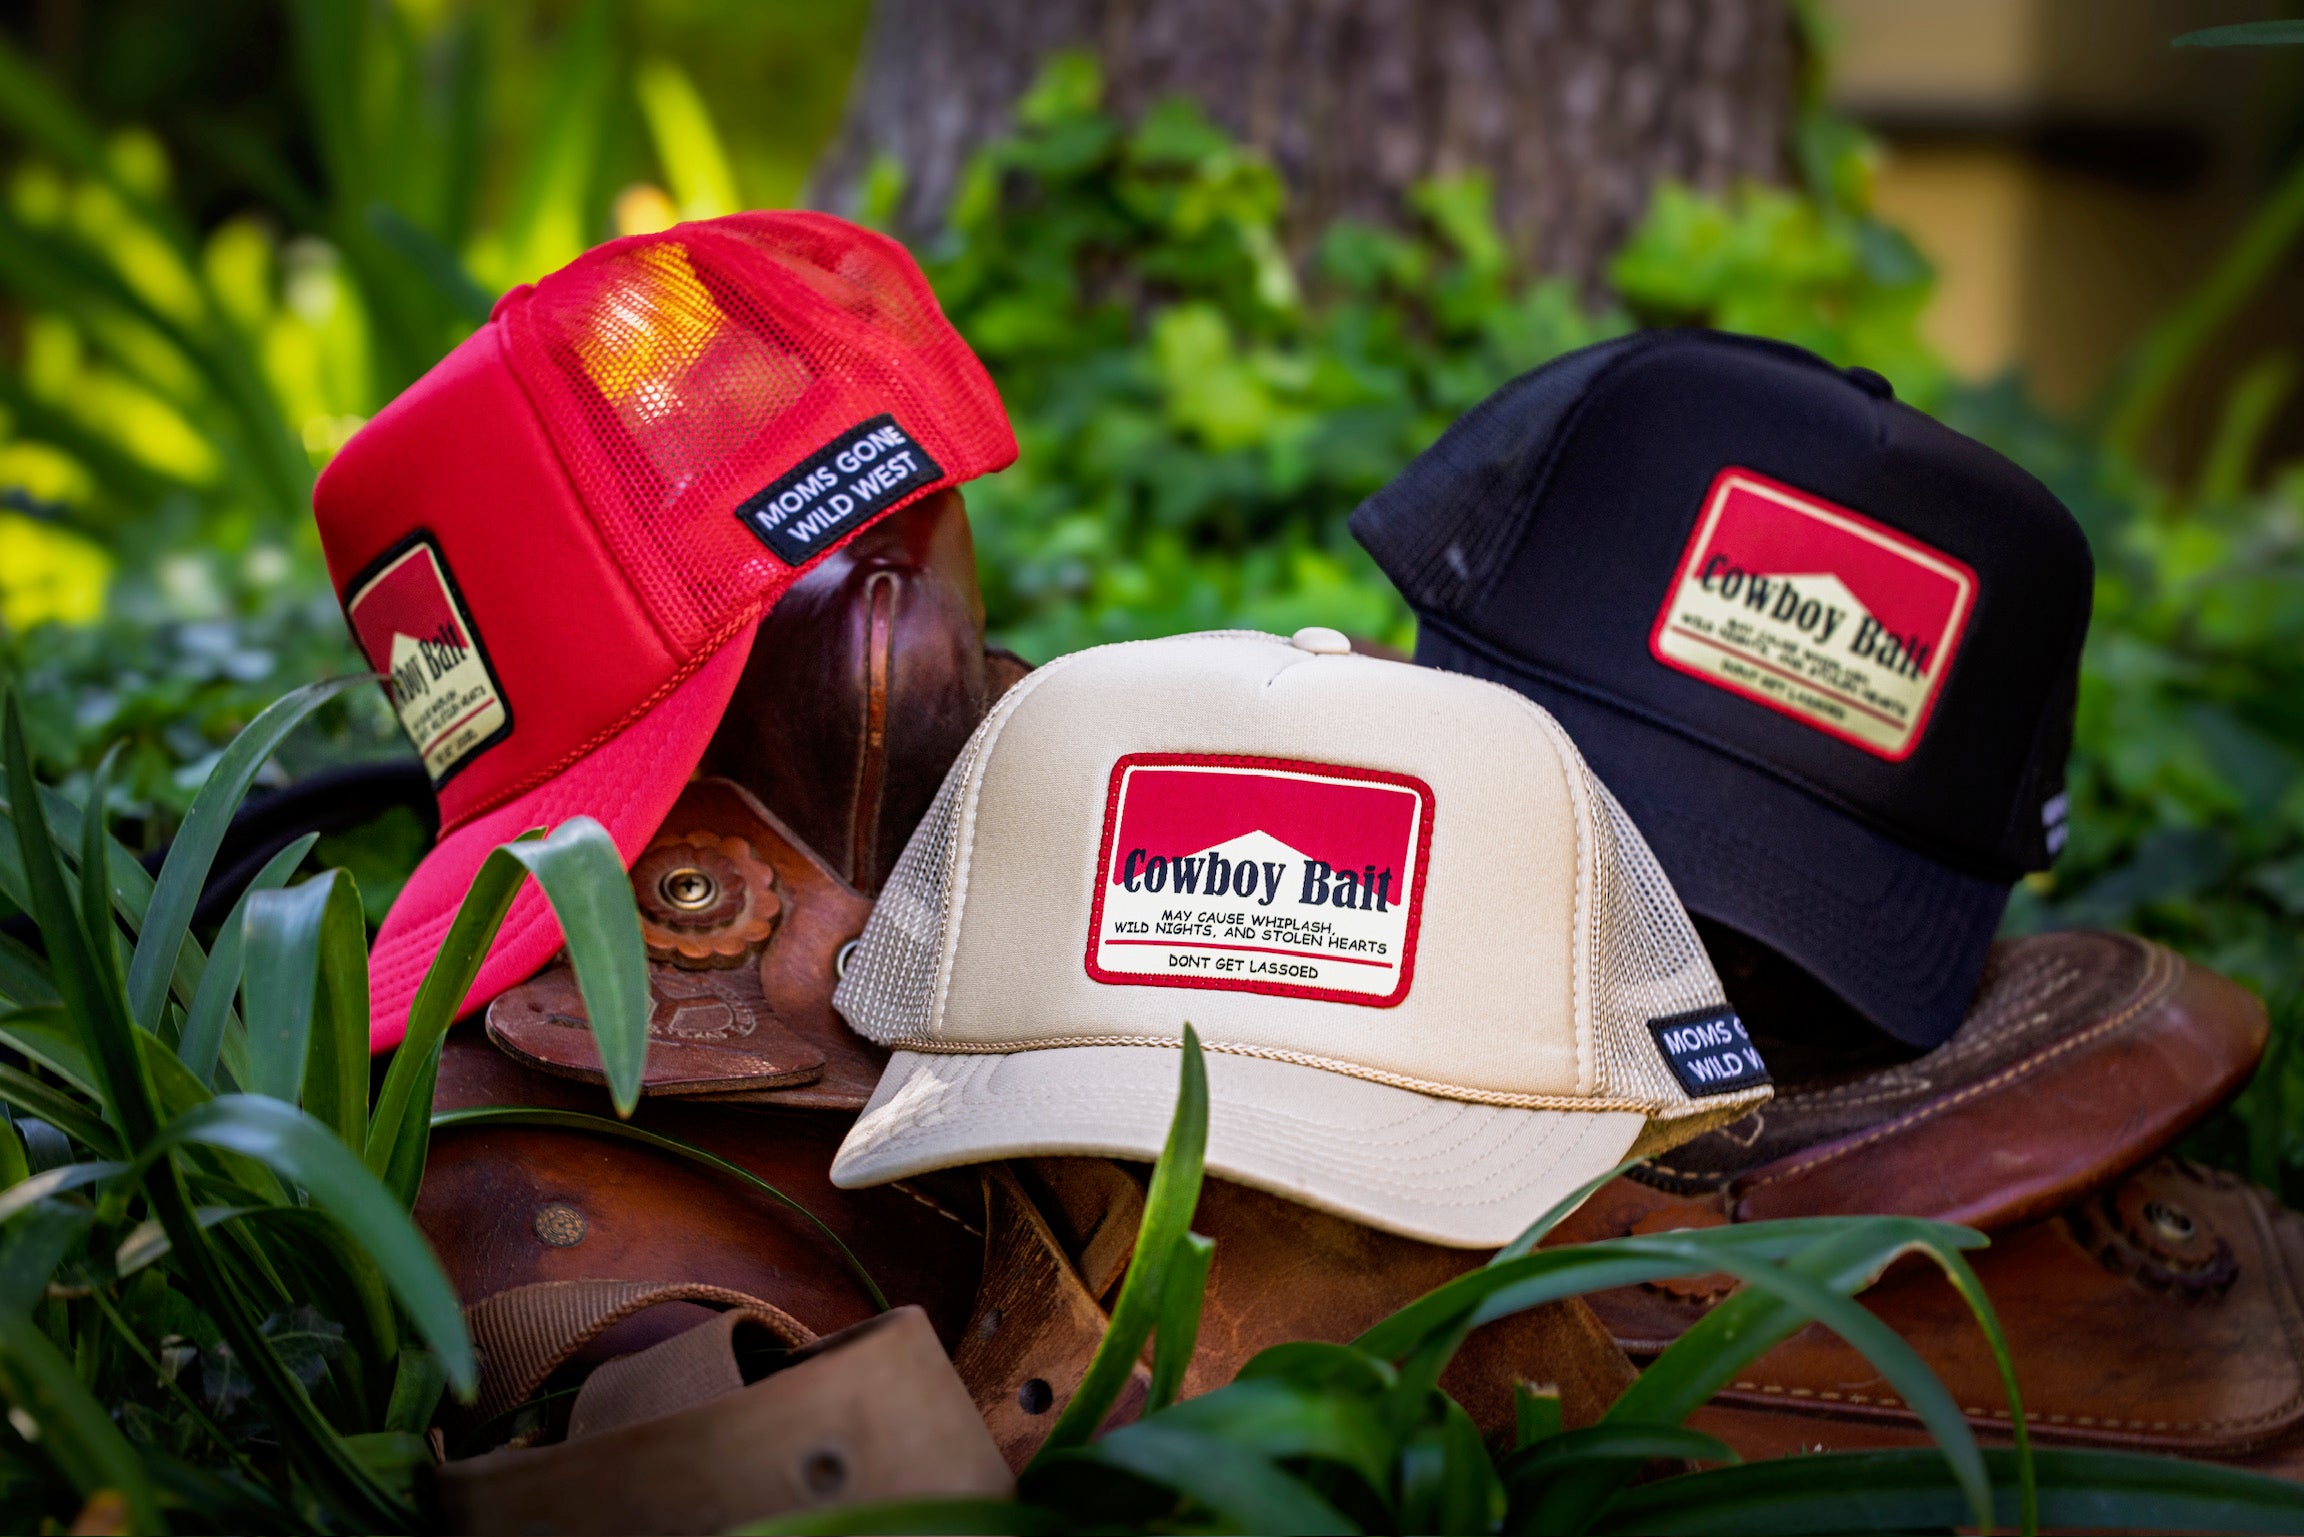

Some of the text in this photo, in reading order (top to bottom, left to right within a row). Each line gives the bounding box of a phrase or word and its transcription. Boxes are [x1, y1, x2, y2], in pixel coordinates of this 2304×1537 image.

[755, 425, 907, 531] MOMS GONE
[787, 451, 918, 543] WILD WEST
[1701, 554, 1845, 645] Cowboy
[1851, 614, 1930, 683] Bait
[419, 621, 467, 681] Bait
[1122, 848, 1393, 913] Cowboy Bait
[1114, 921, 1388, 955] WILD NIGHTS, AND STOLEN HEARTS
[1161, 909, 1336, 936] MAY CAUSE WHIPLASH,
[1168, 953, 1319, 979] DONT GET LASSOED
[1663, 1020, 1733, 1056] MOMS
[1686, 1052, 1744, 1083] WILD
